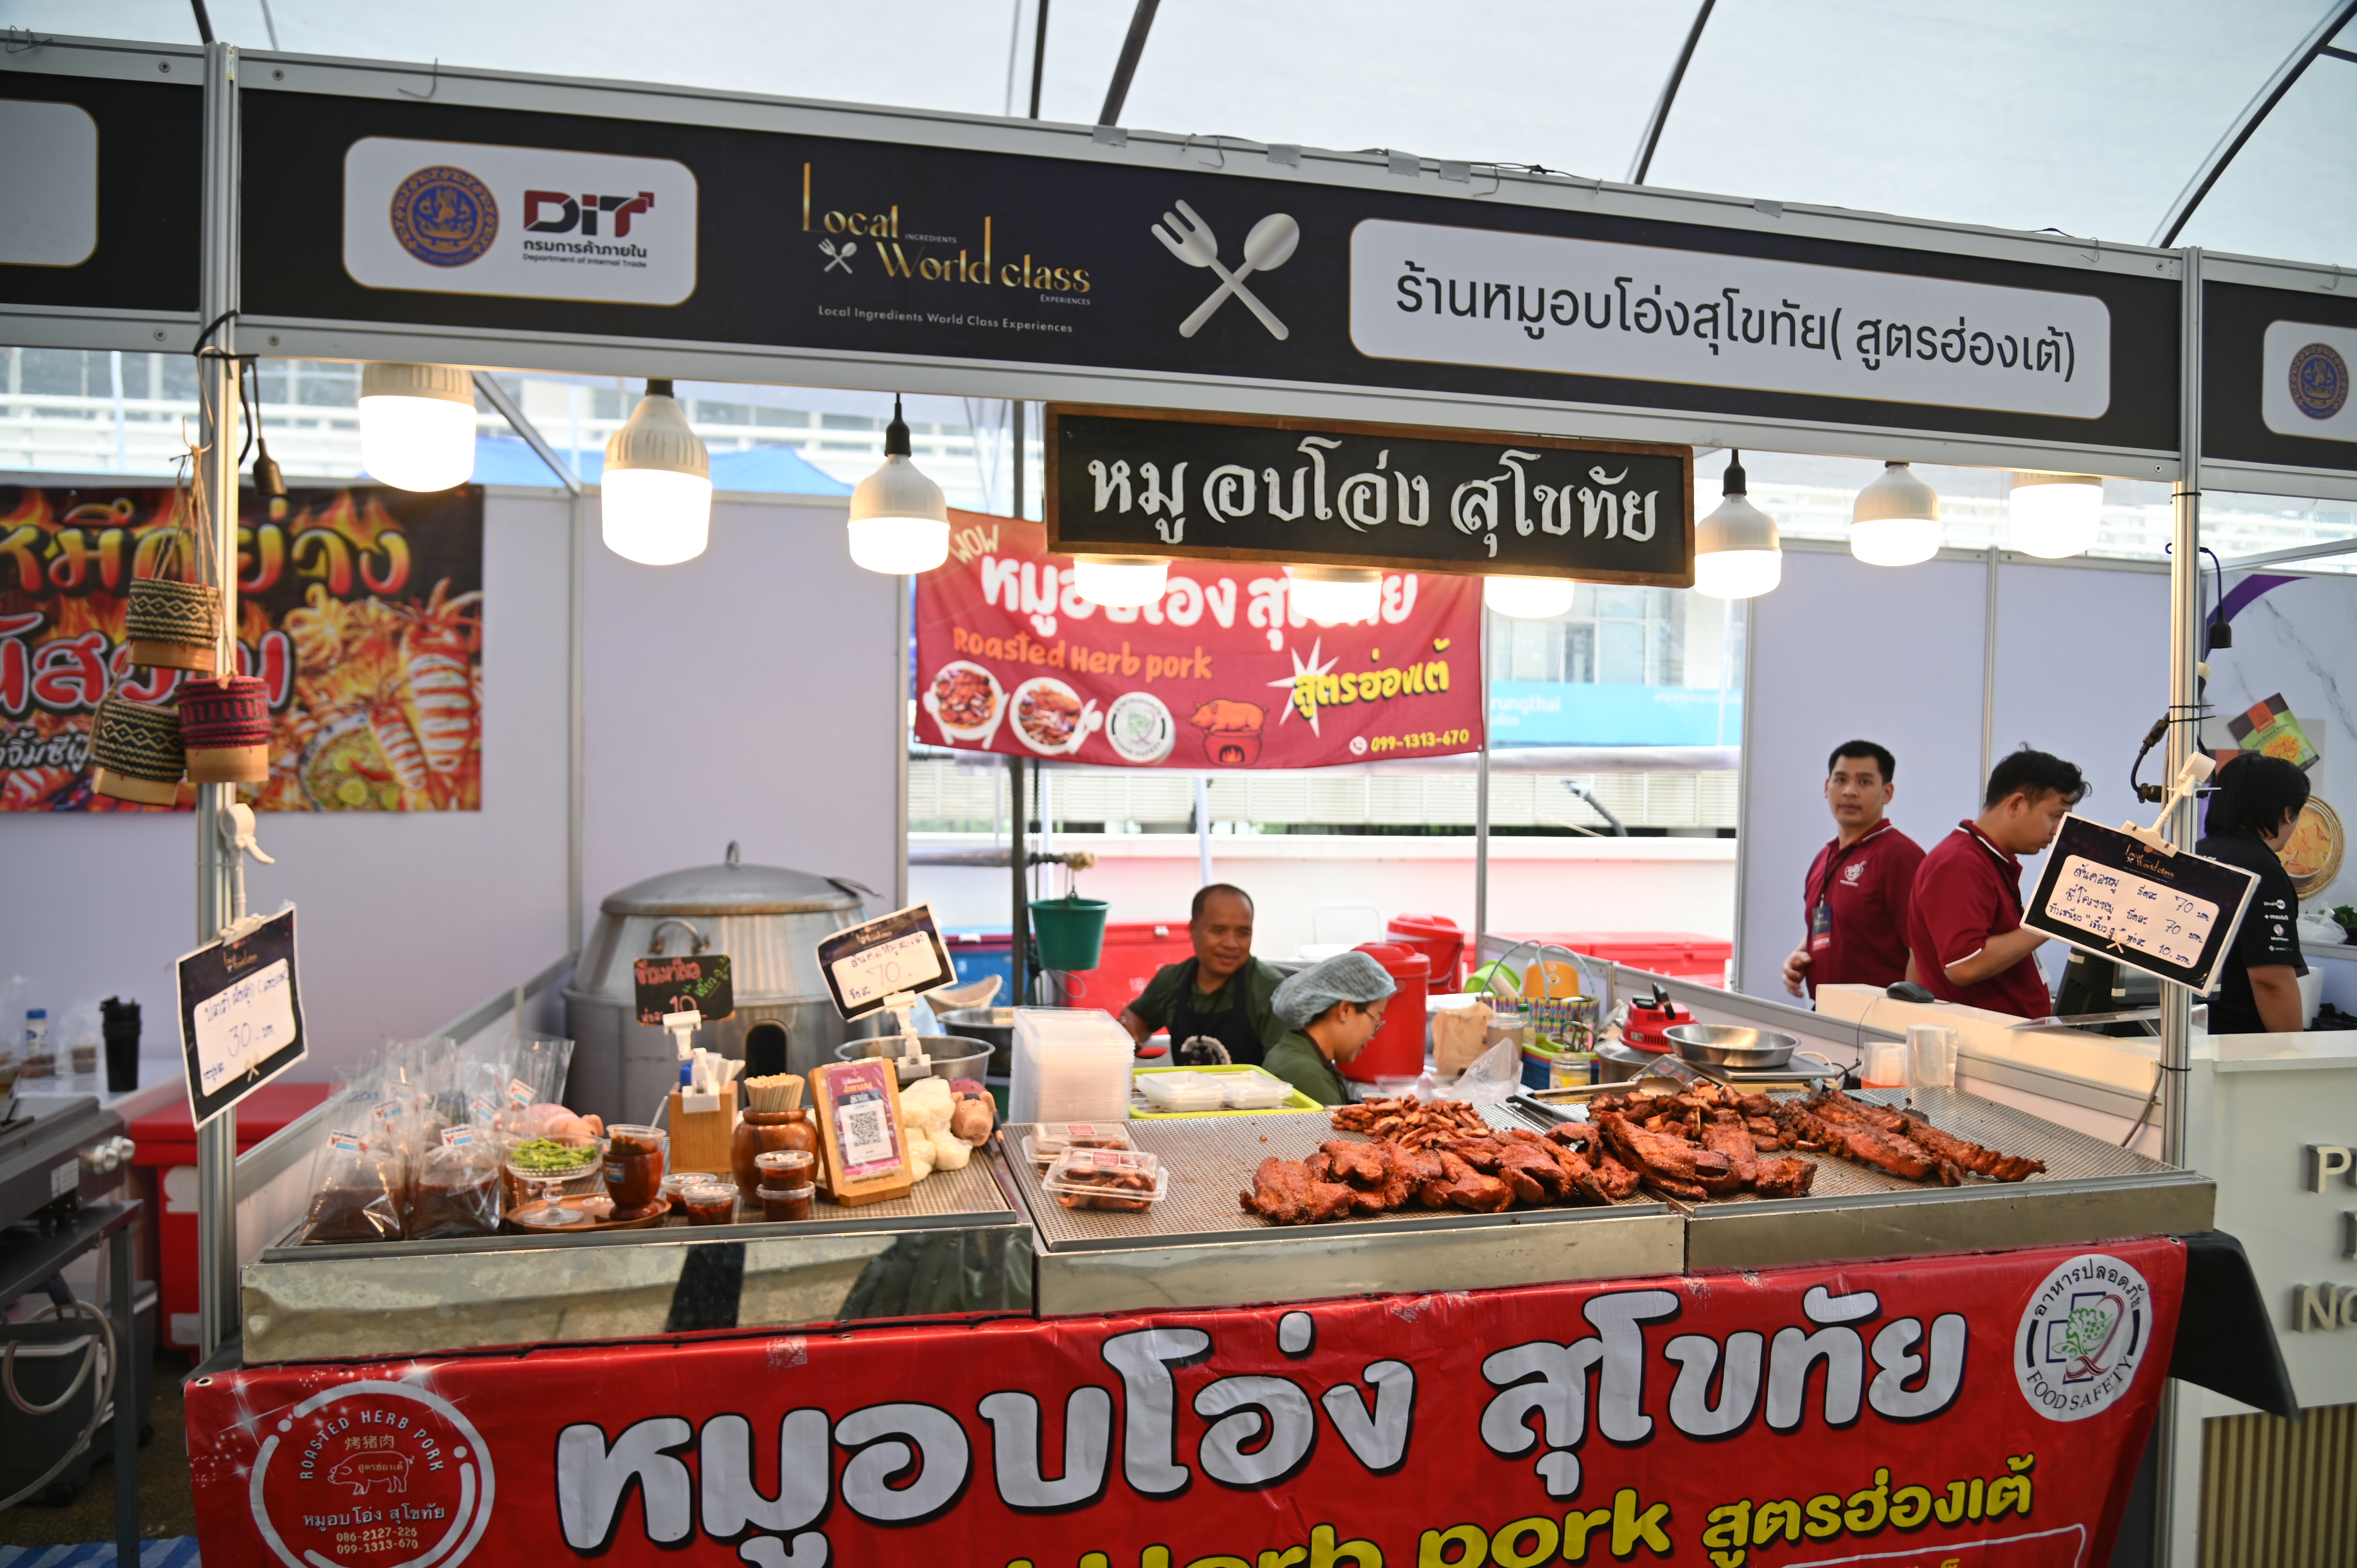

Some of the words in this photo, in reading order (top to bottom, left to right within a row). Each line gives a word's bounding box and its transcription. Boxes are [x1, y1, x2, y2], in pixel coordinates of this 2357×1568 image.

[802, 162, 898, 238] Local
[523, 239, 647, 258] กรมการค้าภายใน
[905, 233, 957, 244] INGREDIENTS
[523, 253, 575, 263] Department
[588, 257, 620, 266] Internal
[624, 259, 647, 267] Trade
[875, 216, 991, 284] World
[1001, 254, 1091, 293] class
[818, 305, 850, 317] Local
[855, 307, 922, 323] Ingredients
[927, 313, 963, 325] World
[967, 316, 998, 327] Class
[1003, 318, 1072, 333] Experiences
[1087, 459, 1187, 544] หมู
[1450, 449, 1660, 558] สุโขทัย
[949, 523, 999, 564] WOW
[953, 627, 1066, 669] Roasted
[1071, 641, 1141, 676] Herb
[1145, 646, 1212, 683] pork
[1293, 638, 1451, 719] สูตรฮ่องเต้
[1370, 728, 1470, 753] 099-1313-670
[2125, 844, 2144, 860] Local
[2175, 895, 2193, 913] 70
[2166, 919, 2181, 934] 70
[866, 961, 900, 985] 70
[669, 995, 698, 1013] 10
[228, 1022, 252, 1057] 30
[2034, 1258, 2145, 1316] อาหารปลอดภัย
[2027, 1370, 2067, 1409] FOOD
[2069, 1355, 2133, 1410] SAFETY
[555, 1310, 1416, 1568] หมูอบโอ่ง
[1480, 1285, 1967, 1498] สุโขทัย
[300, 1417, 350, 1480] ROASTED
[360, 1410, 409, 1430] HERB
[413, 1428, 444, 1472] PORK
[345, 1434, 394, 1451] 烤猪肉
[358, 1461, 403, 1473] สูตรฮ่องเต้
[389, 1503, 445, 1525] สุโขทัย
[1701, 1454, 2035, 1568] สูตรฮ่องเต้
[336, 1526, 417, 1542] 086-2127-226
[1419, 1489, 1672, 1568] pork
[336, 1538, 419, 1554] 099-1313-670
